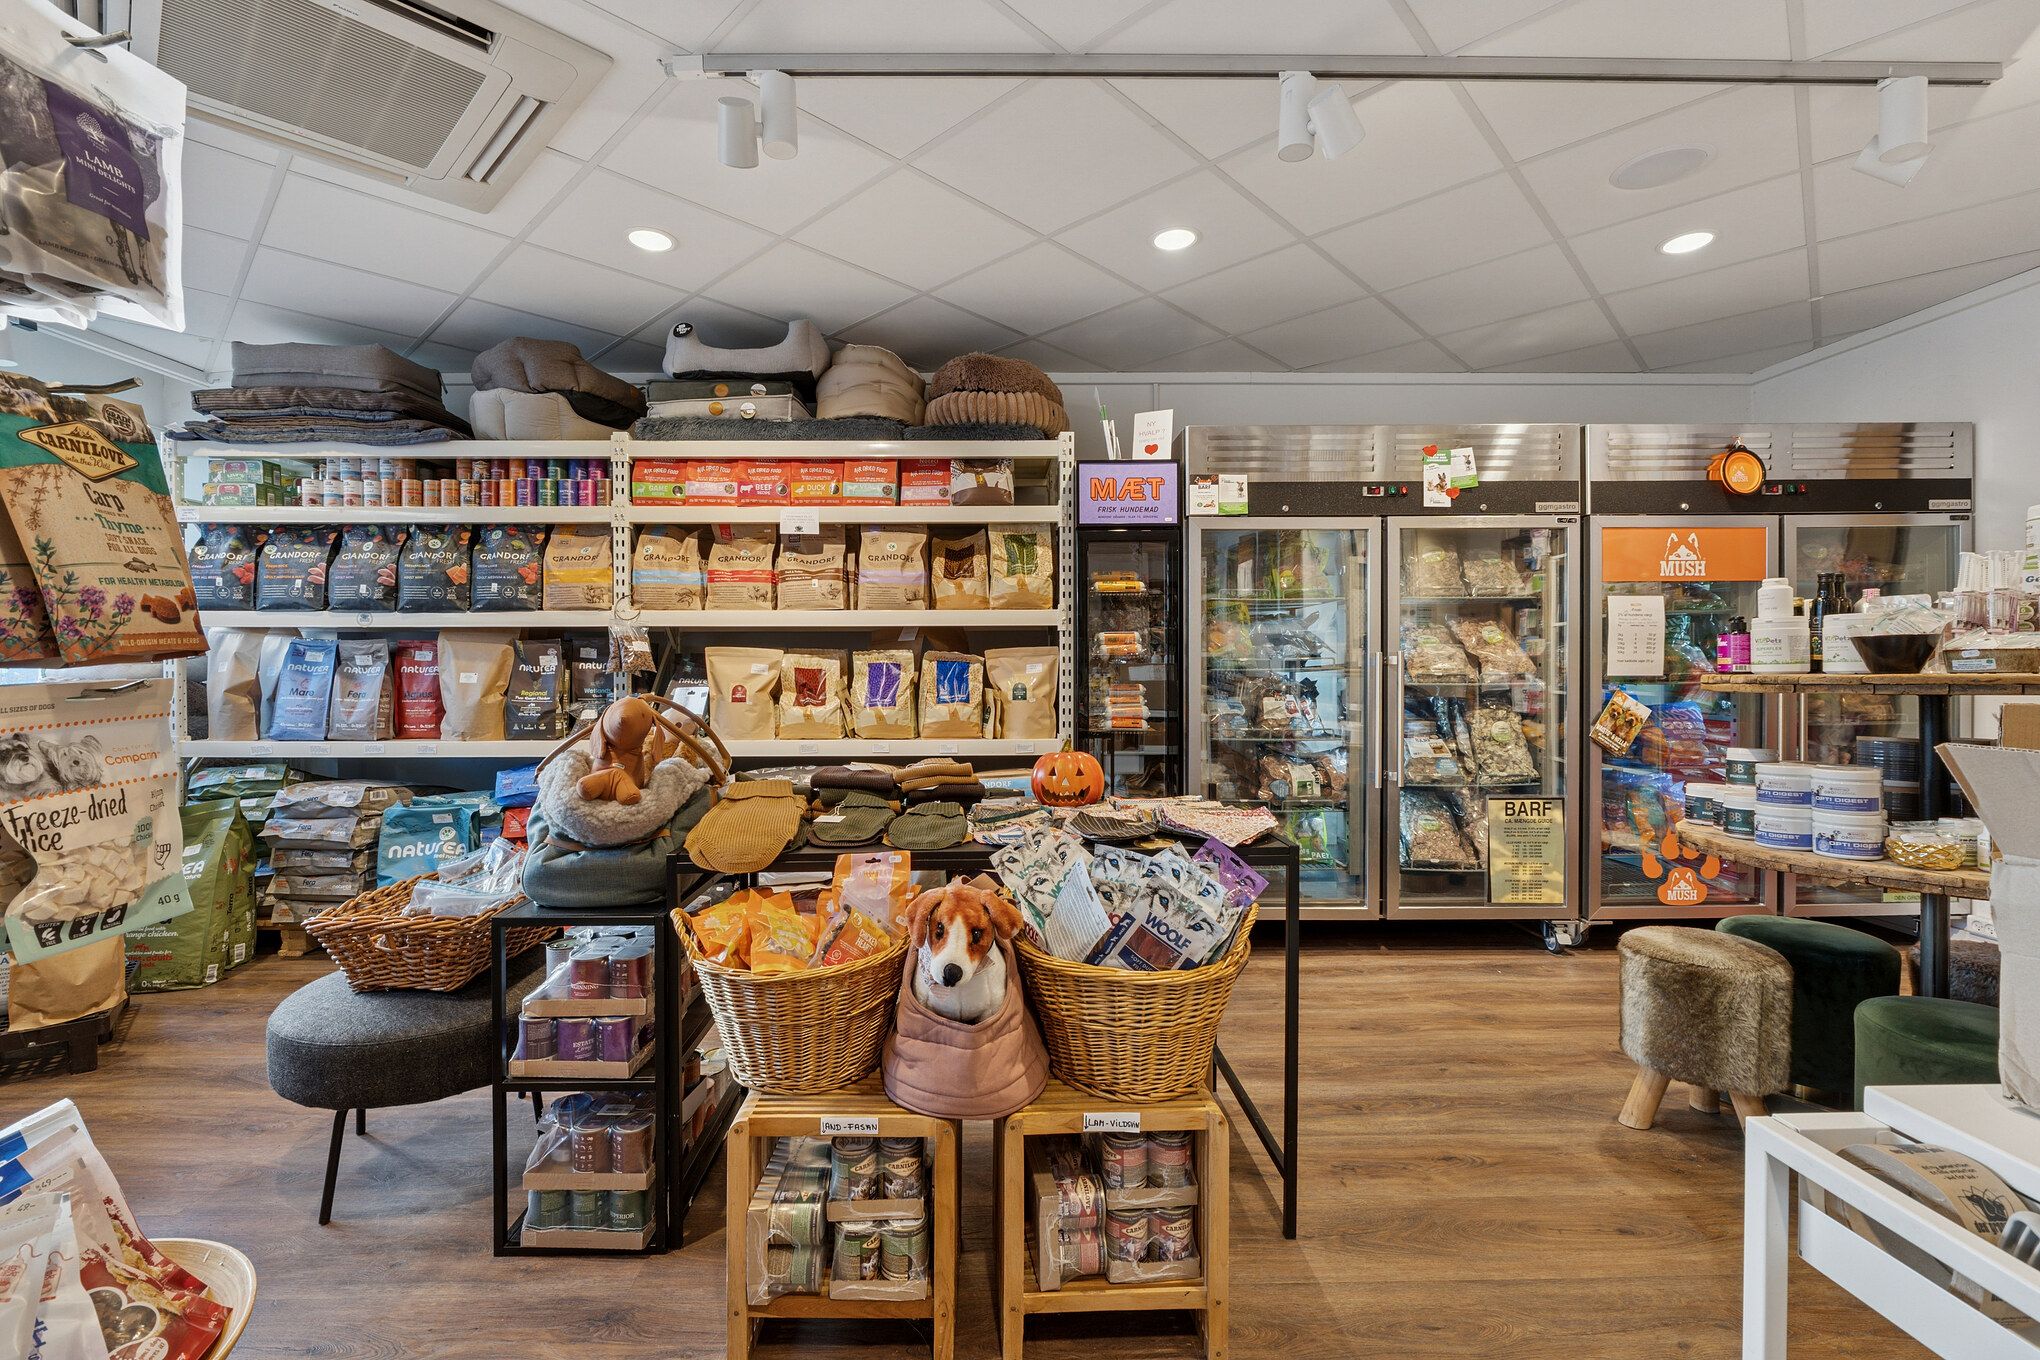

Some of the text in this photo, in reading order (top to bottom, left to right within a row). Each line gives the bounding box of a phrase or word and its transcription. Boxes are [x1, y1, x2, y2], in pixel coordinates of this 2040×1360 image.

[84, 150, 124, 178] LAMB
[75, 155, 136, 194] MINI DELIGHTS
[36, 430, 126, 466] CARNILOVE
[1090, 477, 1165, 501] MÆT
[82, 482, 126, 513] Carp
[1538, 503, 1577, 511] ggmgastro
[94, 512, 145, 535] Thyme
[105, 533, 149, 546] SOFT SNACK
[106, 542, 123, 552] FOR
[123, 544, 137, 554] ALL
[480, 551, 530, 560] GRANDORF
[552, 553, 600, 562] GRANDORF
[643, 554, 690, 563] GRANDORF
[787, 556, 836, 565] GRANDORF
[868, 553, 914, 563] GRANDORF
[1659, 560, 1706, 577] MUSH
[98, 577, 186, 587] FOR HEALTHY METABOLISM
[119, 638, 158, 647] WILD-ORIGIN
[182, 637, 200, 645] HERBS
[10, 704, 28, 714] SIZES
[29, 704, 37, 712] OF
[38, 703, 55, 711] DOGS
[984, 779, 1012, 788] NDORF
[3, 788, 128, 838] Freeze-dried
[1504, 801, 1553, 817] BARF
[19, 828, 65, 852] dice
[1853, 842, 1881, 850] DIGEST
[302, 879, 316, 887] Fera
[157, 893, 181, 906] 40 g
[1667, 890, 1698, 900] MUSH
[147, 930, 179, 938] chicken.
[1145, 911, 1192, 950] WOOLF
